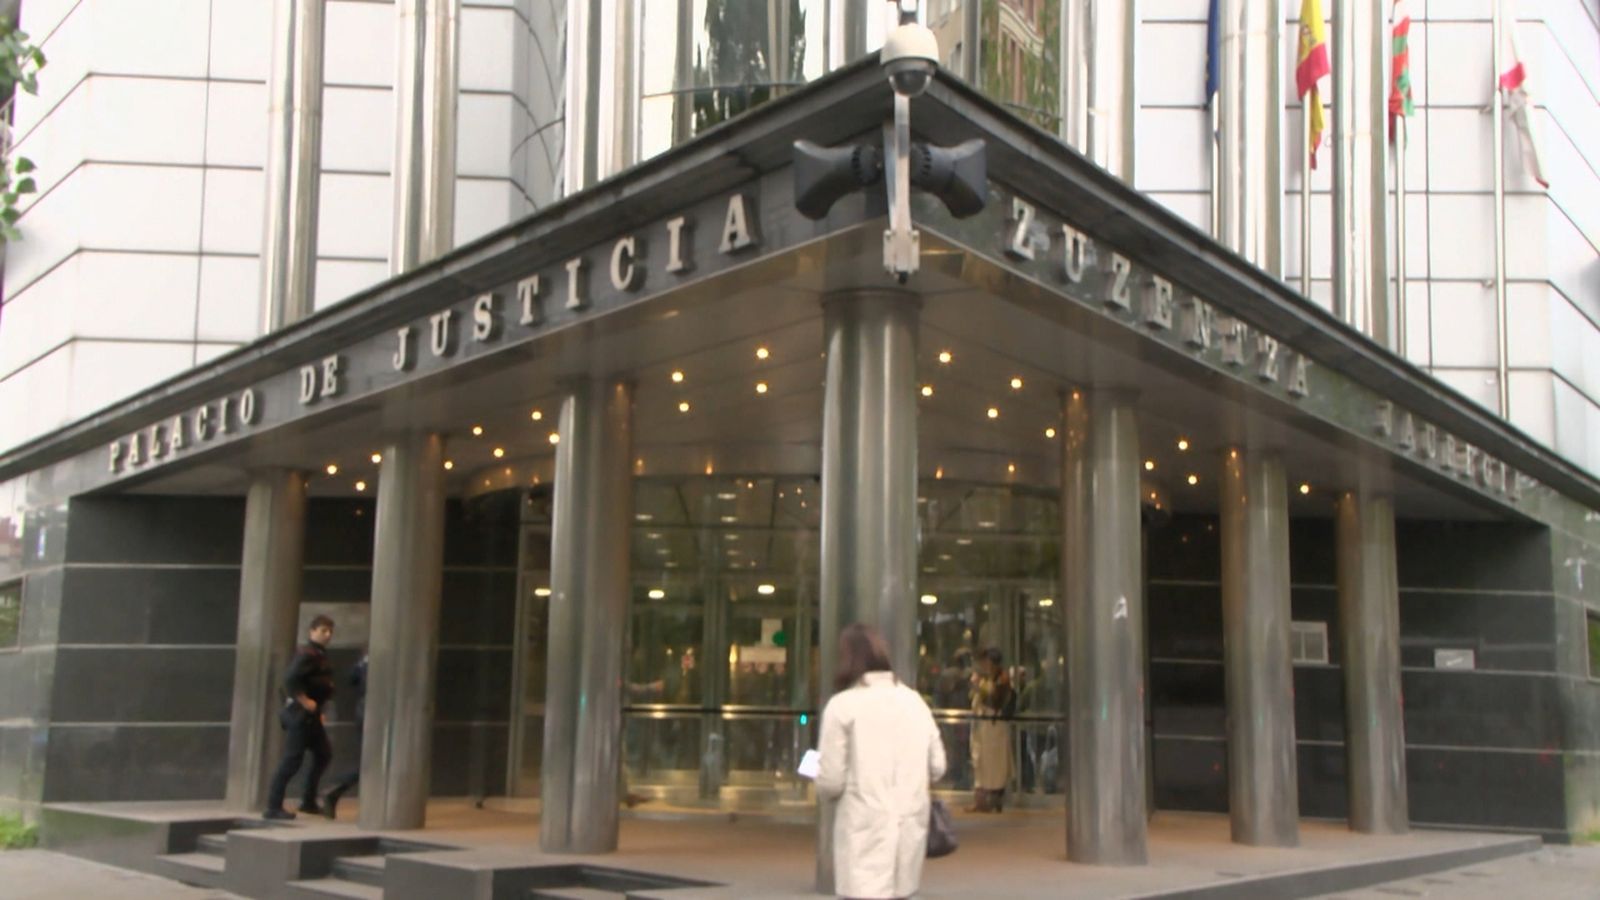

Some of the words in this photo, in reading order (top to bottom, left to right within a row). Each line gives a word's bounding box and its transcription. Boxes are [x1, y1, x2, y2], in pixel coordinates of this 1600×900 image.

[107, 388, 256, 474] PALACIO
[299, 354, 341, 405] DE
[392, 193, 756, 372] JUSTICIA
[1009, 196, 1310, 398] ZUZENTZA
